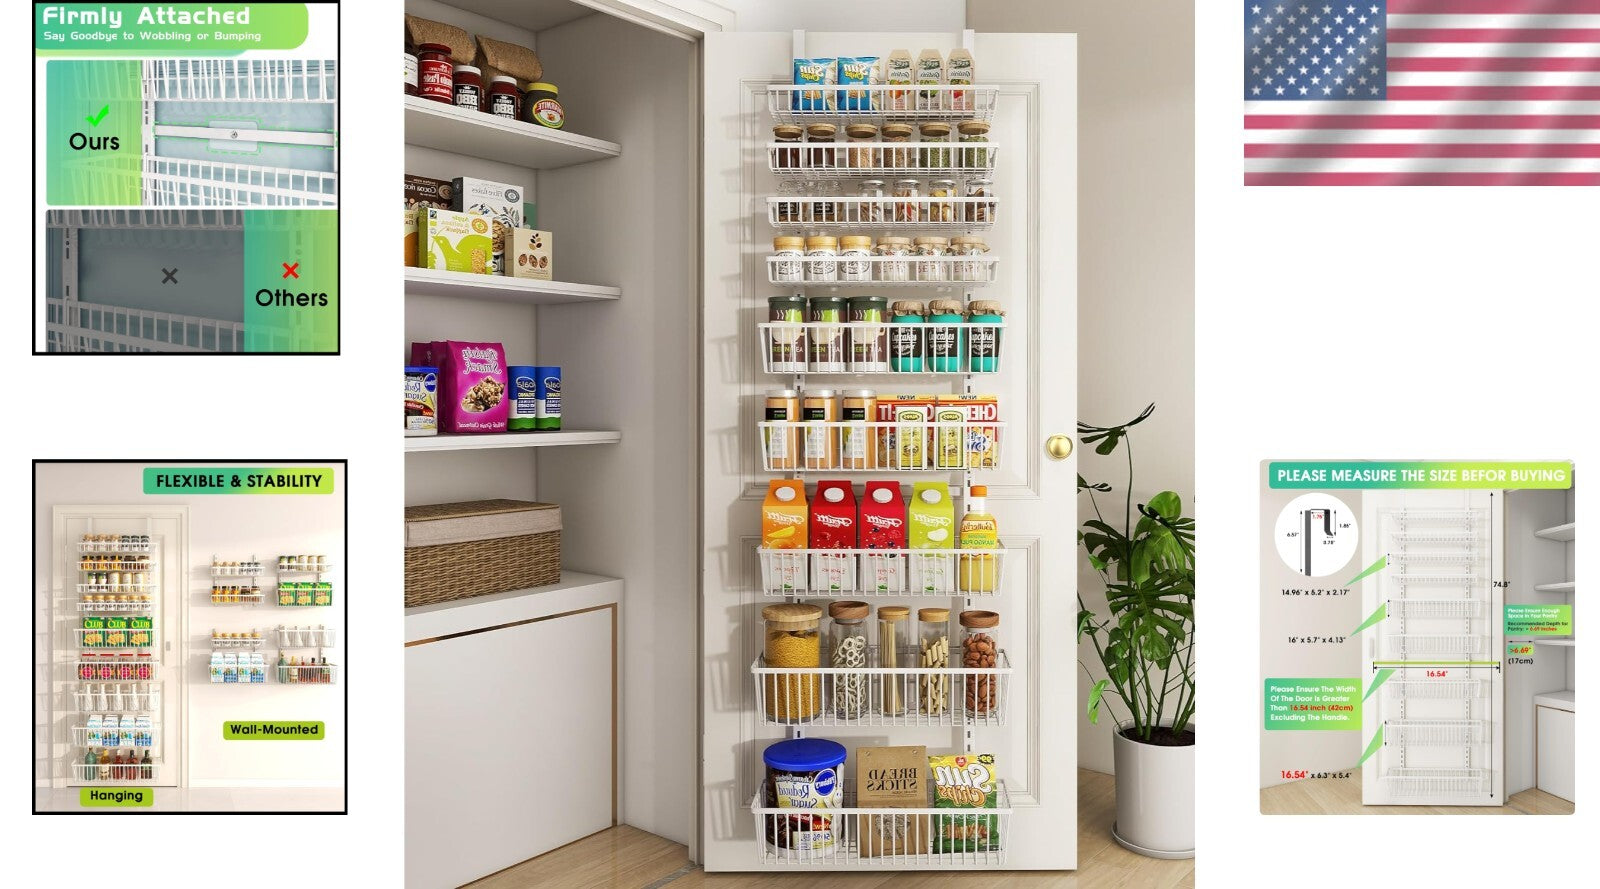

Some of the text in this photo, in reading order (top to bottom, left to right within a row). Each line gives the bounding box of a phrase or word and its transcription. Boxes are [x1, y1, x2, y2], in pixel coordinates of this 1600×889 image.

[84, 620, 103, 628] CLUB
[108, 620, 126, 628] CLUB
[132, 620, 150, 628] CLUB
